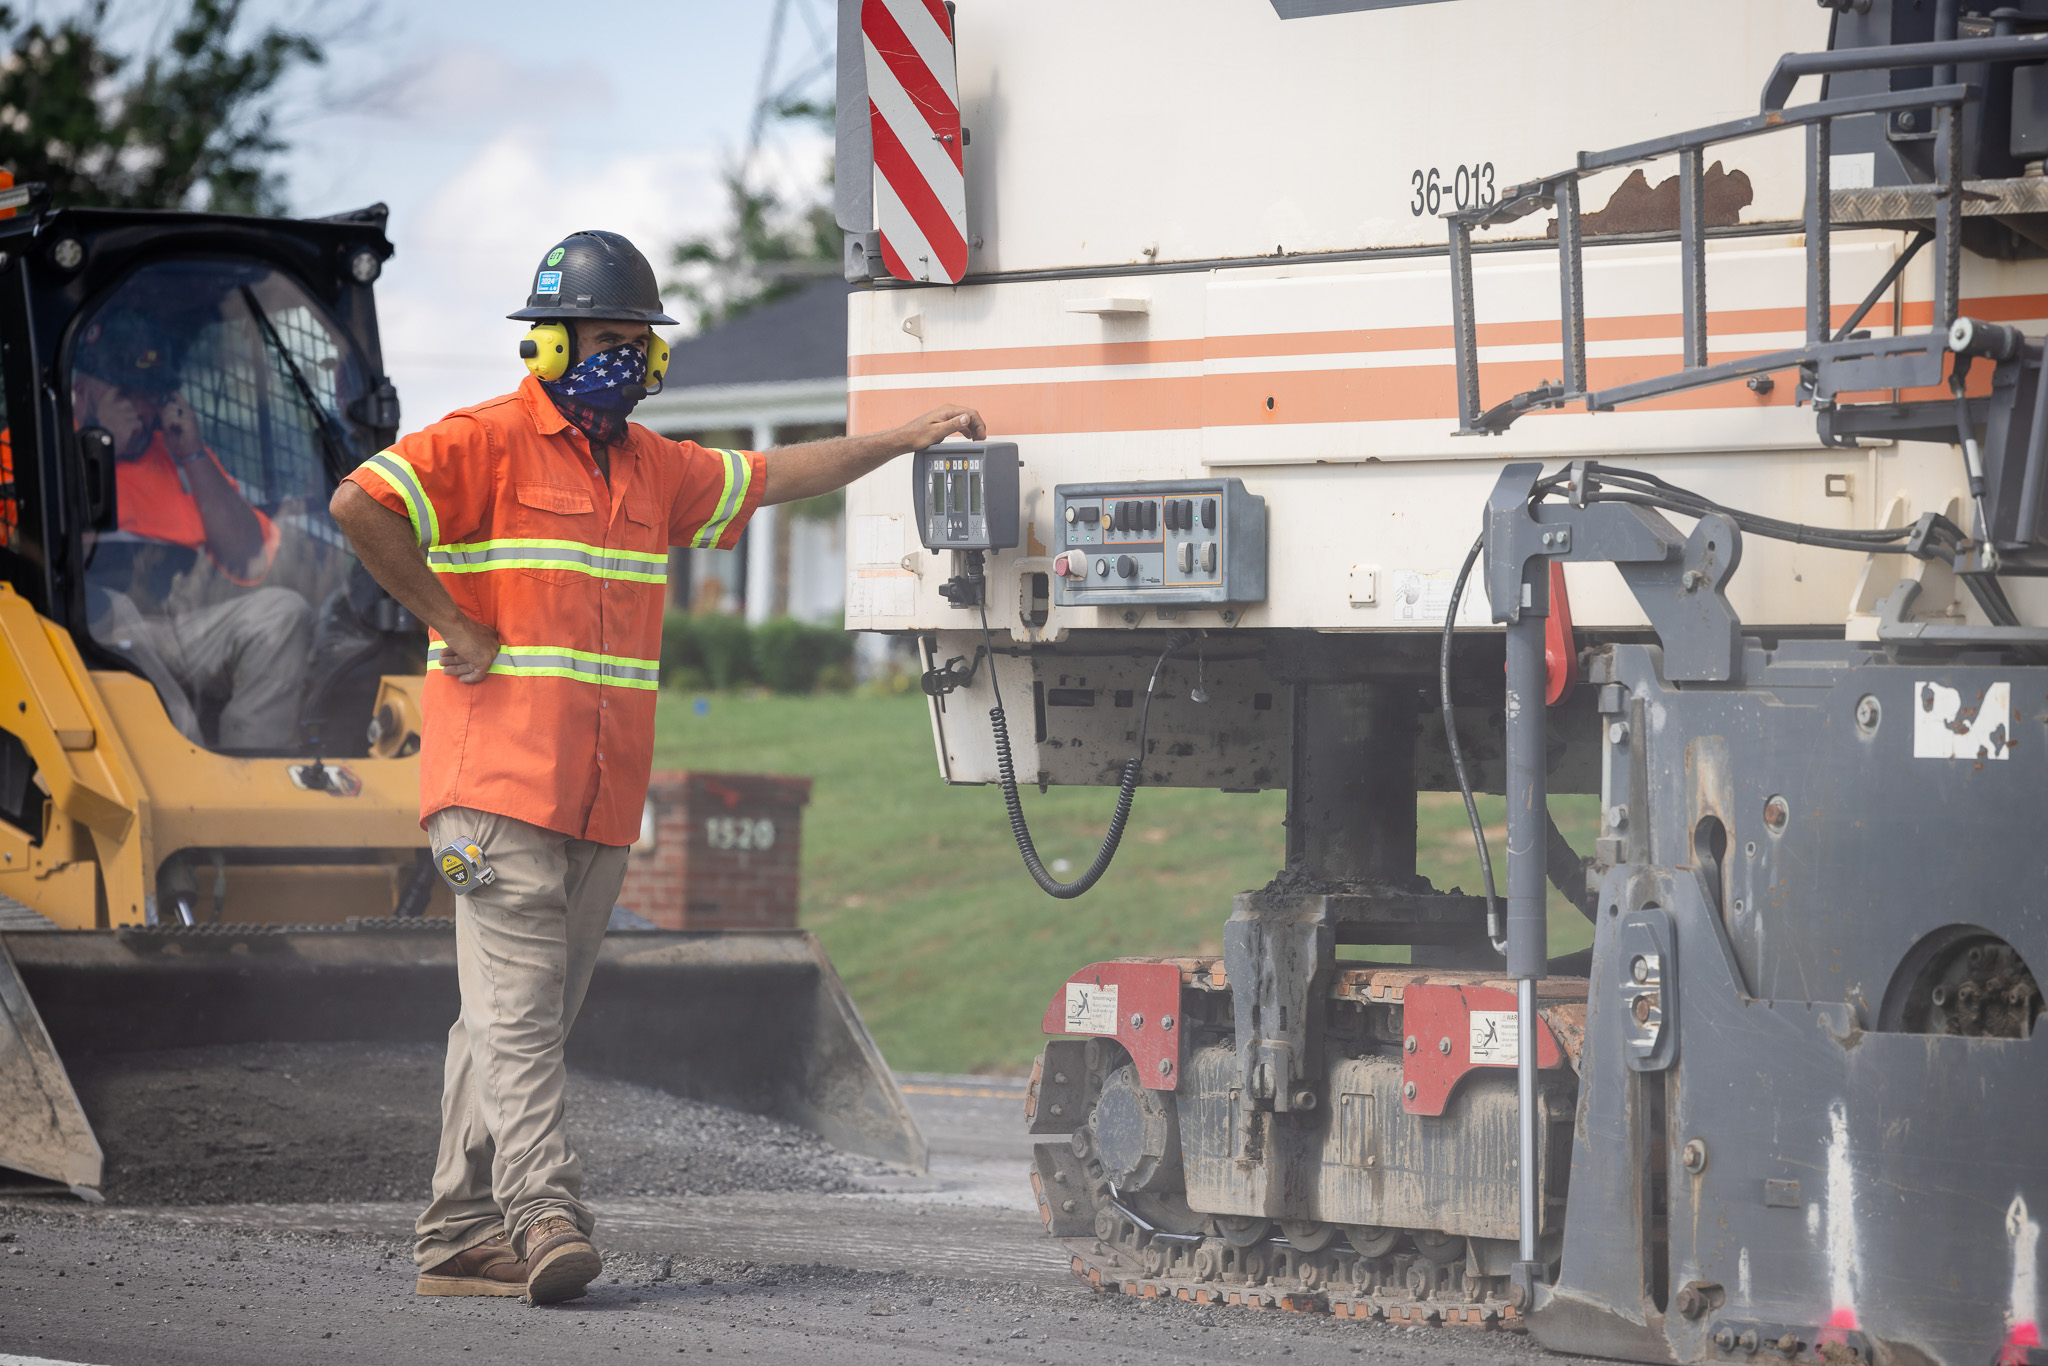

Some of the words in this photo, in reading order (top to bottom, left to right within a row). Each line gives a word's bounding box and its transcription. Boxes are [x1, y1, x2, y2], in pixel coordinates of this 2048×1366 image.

[1410, 161, 1495, 217] 36-013
[540, 277, 556, 285] 2024
[706, 816, 776, 850] 1520
